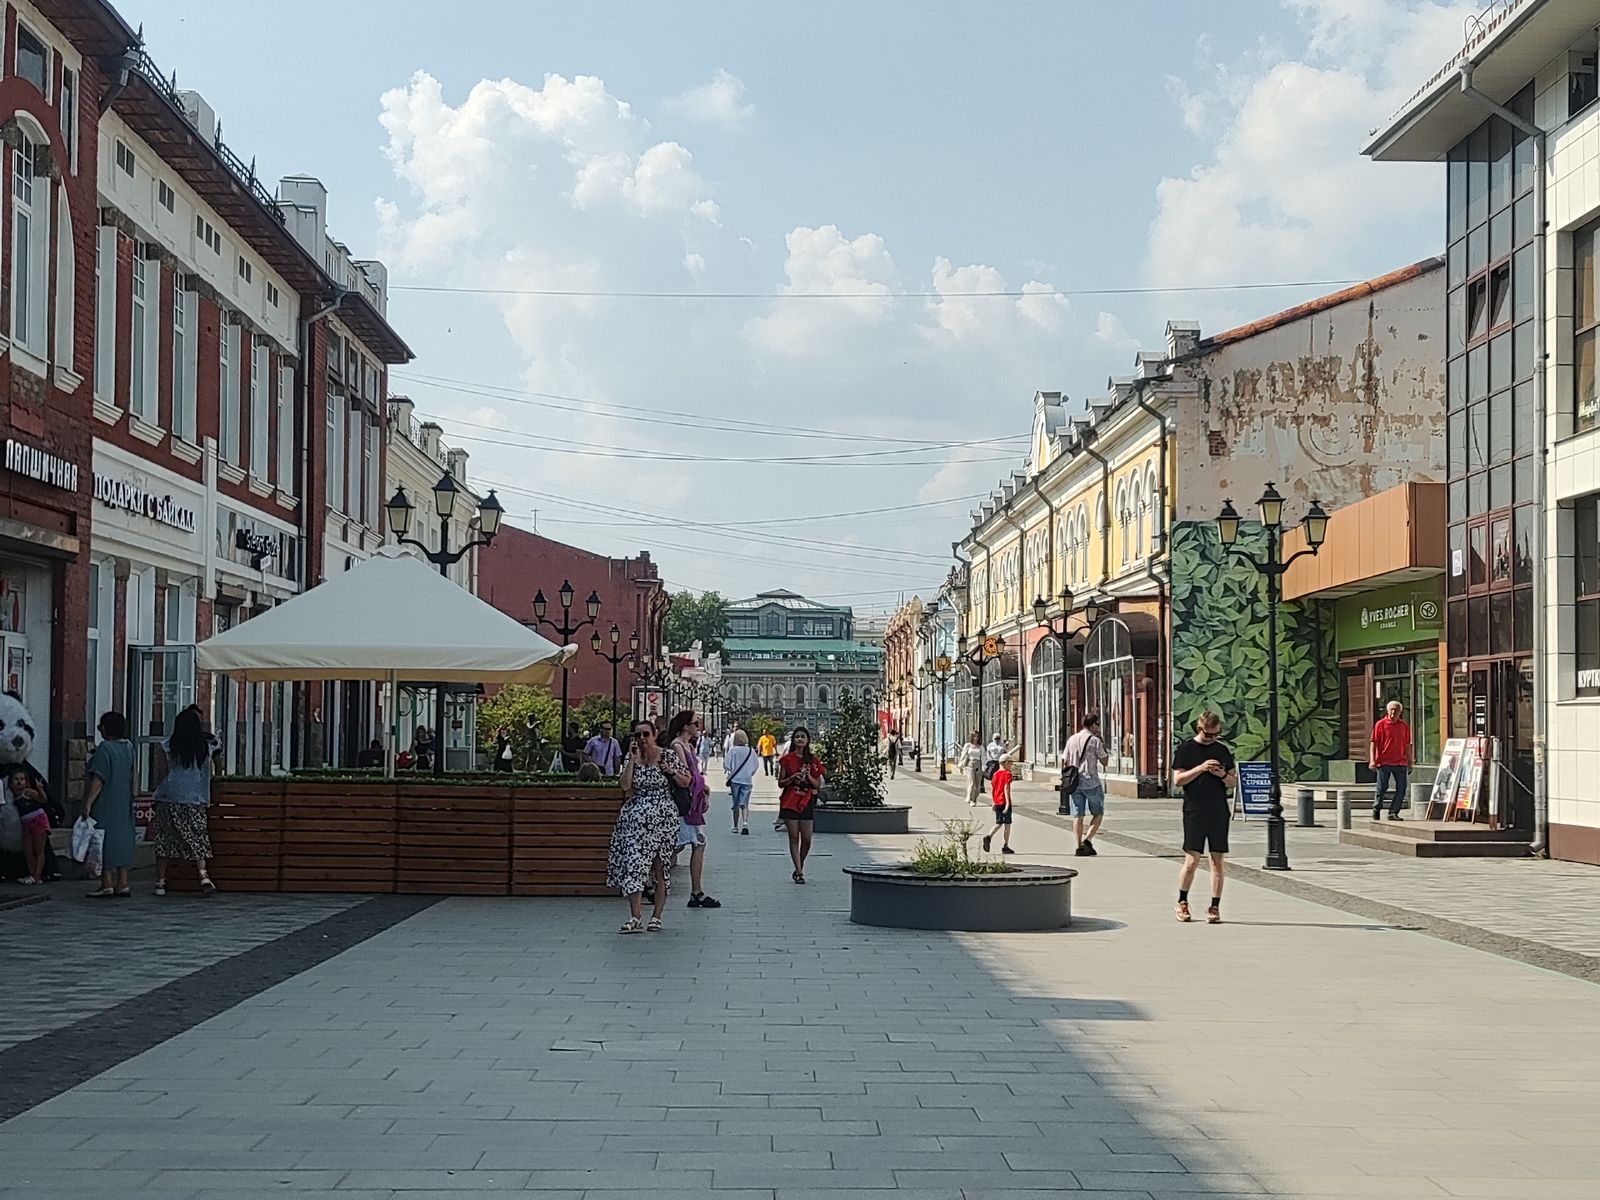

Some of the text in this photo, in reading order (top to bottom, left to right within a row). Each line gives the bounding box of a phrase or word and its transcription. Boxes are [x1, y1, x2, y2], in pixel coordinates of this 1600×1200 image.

[94, 473, 197, 534] ПОДАРКИ С БАЙКАЛА
[1369, 604, 1409, 623] YVES ROCHER
